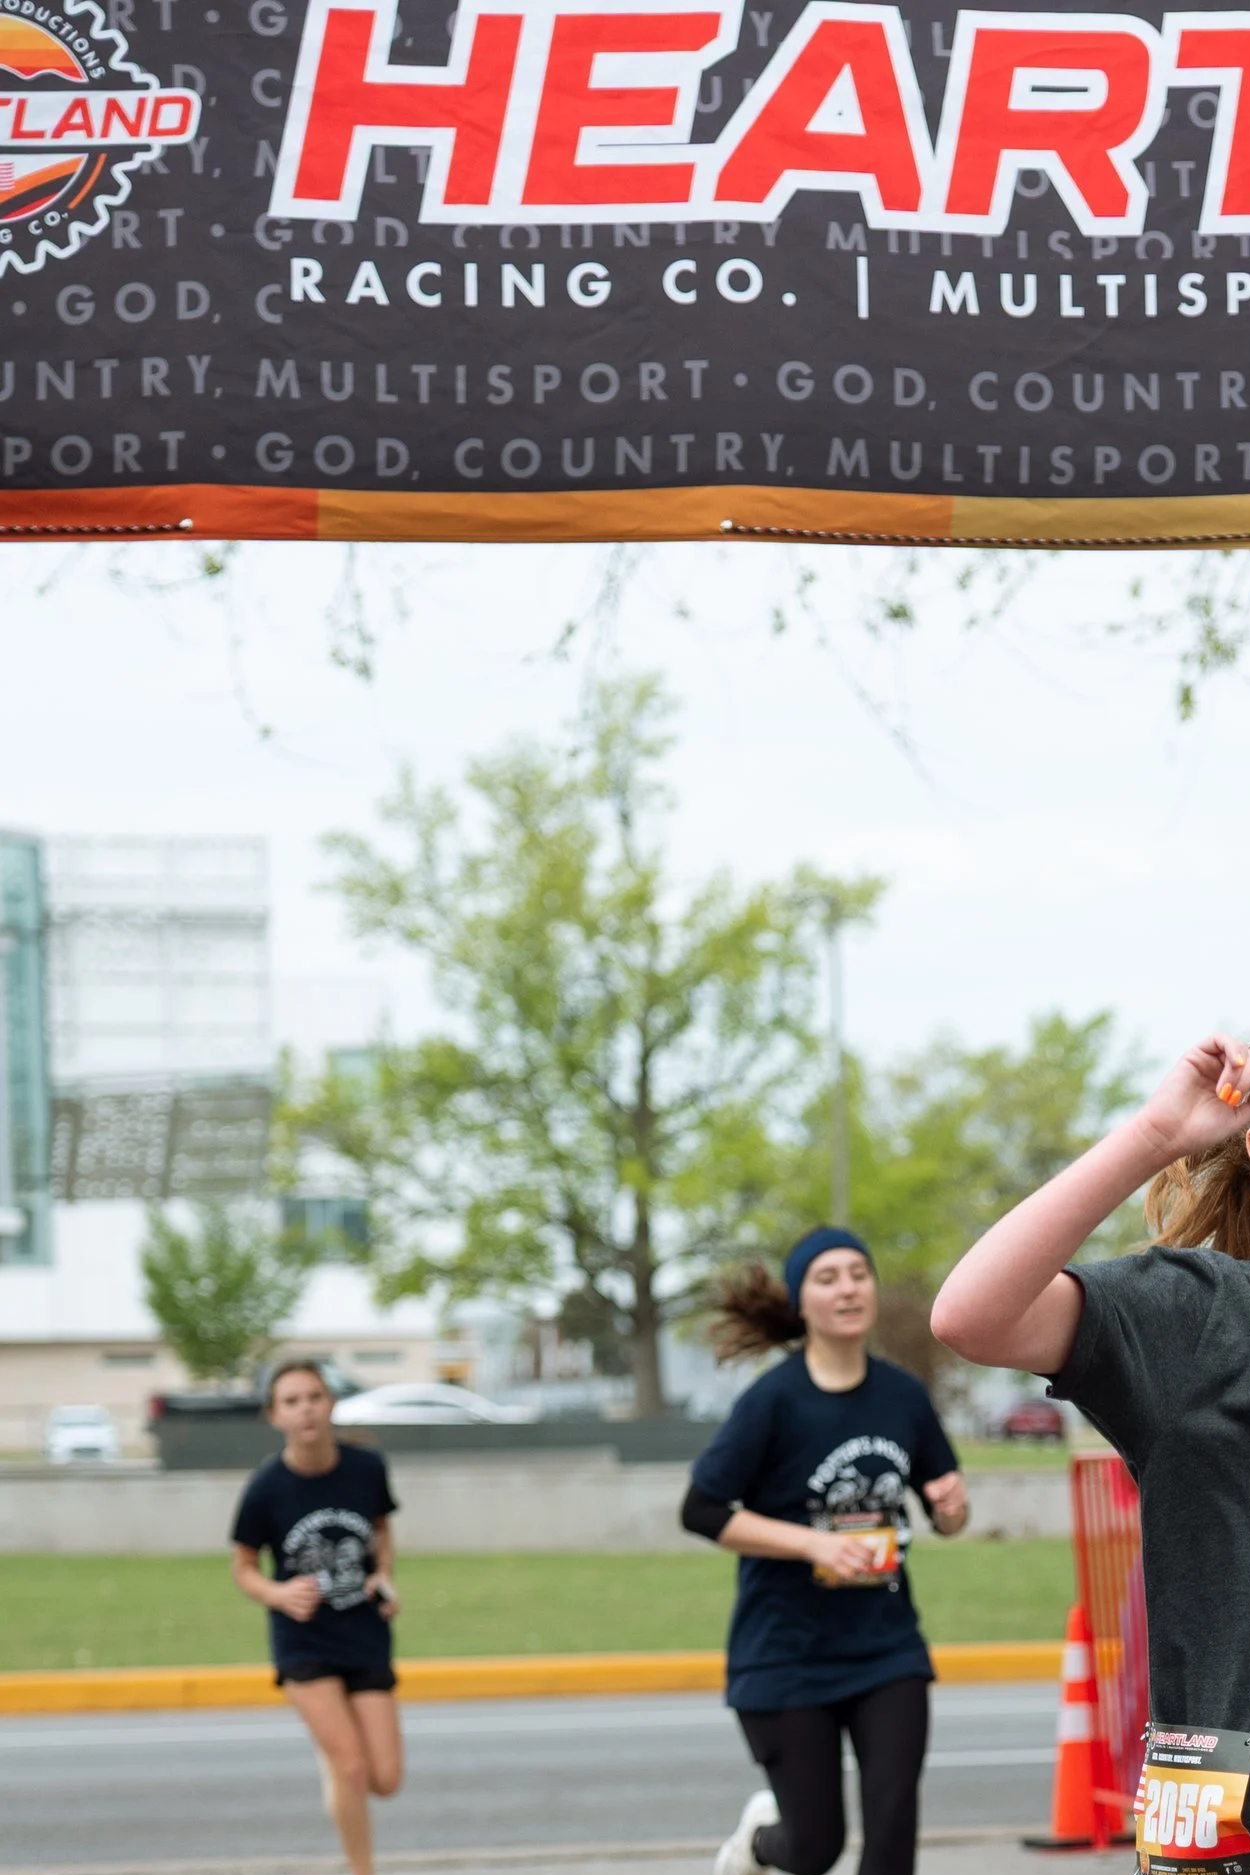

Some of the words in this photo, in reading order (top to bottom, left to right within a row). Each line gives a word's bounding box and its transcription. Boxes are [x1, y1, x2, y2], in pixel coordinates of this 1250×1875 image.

[0, 96, 195, 140] LAND
[56, 281, 222, 326] GOD,
[289, 256, 613, 308] RACING
[662, 257, 798, 306] CO.
[256, 358, 709, 405] MULTISPORT
[776, 361, 938, 410] GOD,
[255, 431, 420, 482] GOD,
[454, 431, 796, 479] COUNTRY,
[1143, 1779, 1225, 1849] 2056
